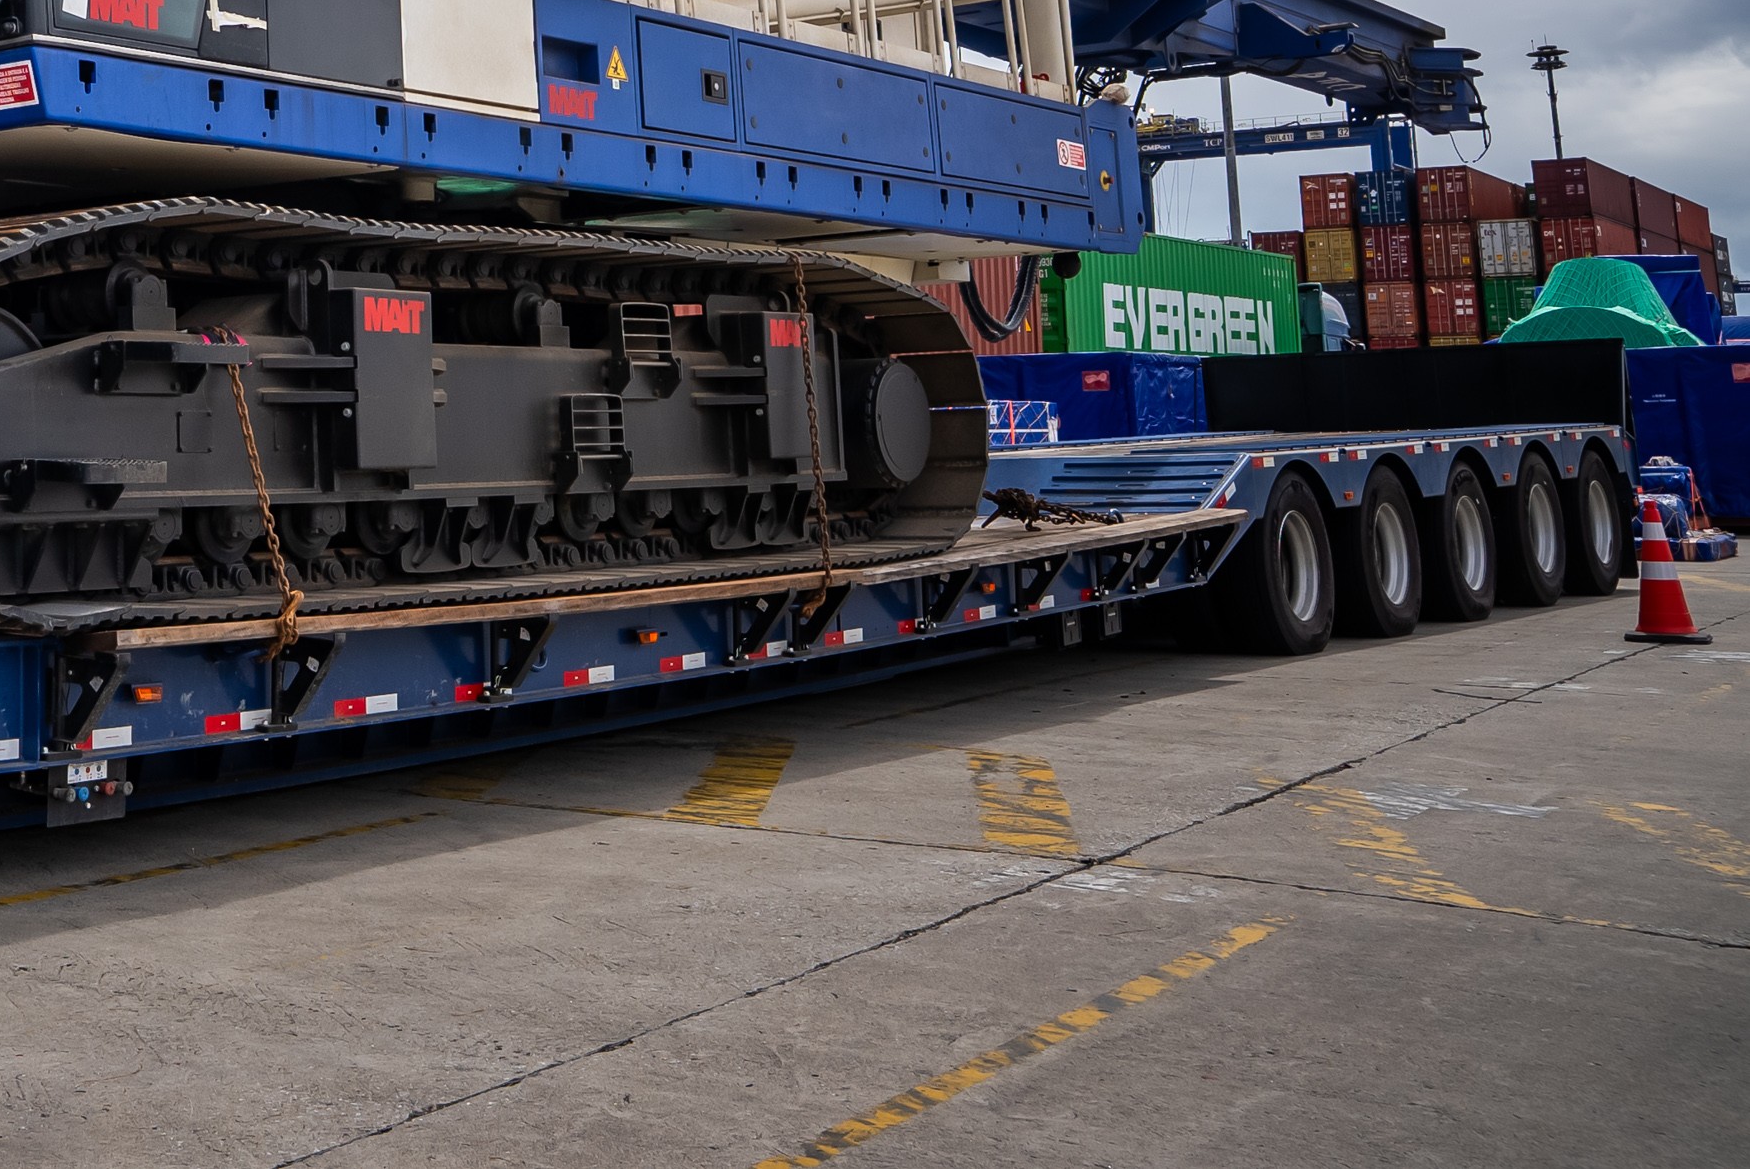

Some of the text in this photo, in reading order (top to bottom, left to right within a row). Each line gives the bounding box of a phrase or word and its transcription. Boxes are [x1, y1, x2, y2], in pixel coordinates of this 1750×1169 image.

[547, 84, 598, 120] MAIT
[1202, 138, 1223, 148] TCP
[1338, 128, 1349, 138] 32
[363, 296, 425, 335] MAIT
[1102, 282, 1276, 355] EVERGREEN
